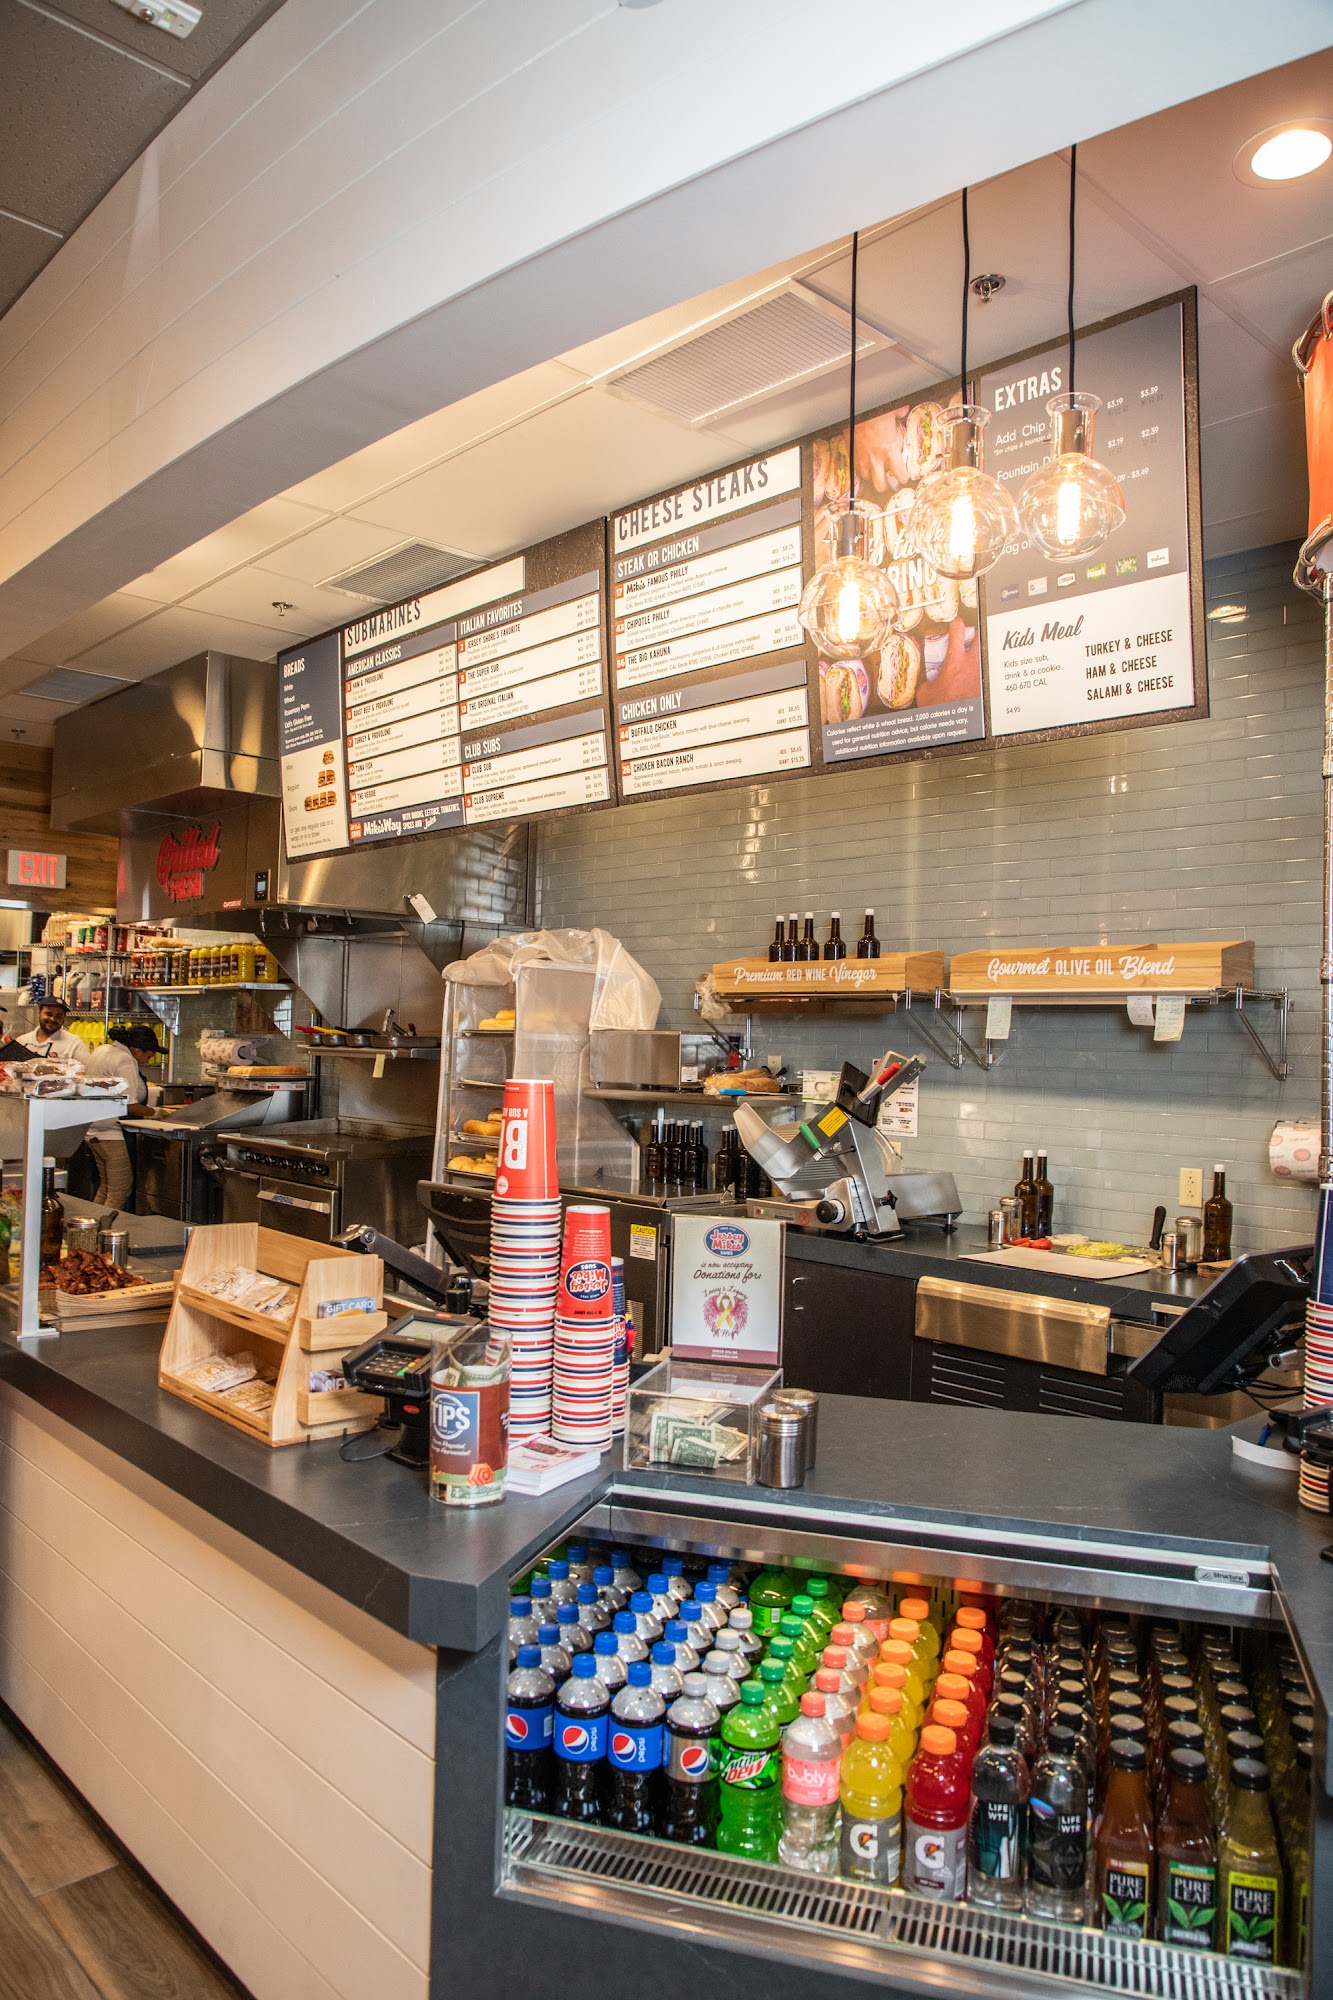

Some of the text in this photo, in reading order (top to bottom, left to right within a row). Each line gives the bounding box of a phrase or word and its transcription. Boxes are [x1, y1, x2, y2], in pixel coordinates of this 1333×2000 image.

[995, 367, 1062, 412] EXTRAS
[1107, 386, 1158, 409] $3.19 $3.39
[995, 421, 1045, 446] Add Chip
[1108, 426, 1158, 448] $2.19 $2.39
[997, 459, 1038, 482] Fountain
[1131, 468, 1149, 479] $3.49
[619, 460, 768, 540] CHEESE STEAKS
[618, 536, 699, 578] STEAK OR CHICKEN
[616, 566, 688, 596] 17 Mike's FAMOUS PHILLY
[348, 599, 420, 646] SUBMARINES
[461, 600, 522, 635] ITALIAN FAVORITES
[616, 610, 670, 632] 43 CHIPOTLE PHILLY
[467, 639, 481, 649] JERSEY
[483, 632, 499, 643] SHORE'S
[501, 624, 520, 636] FAVORITE
[1003, 615, 1084, 650] Kids Meal
[1085, 629, 1173, 657] TURKEY & CHEESE
[348, 645, 401, 676] AMERICAN CLASSICS
[617, 646, 671, 668] 56 THE BIG KAHUNA
[1004, 654, 1049, 668] Kids size sub,
[1086, 655, 1157, 679] HAM & CHEESE
[284, 658, 305, 678] BREADS
[476, 667, 489, 677] SUPER
[491, 664, 499, 672] SUB
[1005, 672, 1020, 680] drink
[1038, 664, 1062, 674] cookie.
[1005, 678, 1047, 691] 460-670 CAL
[1087, 676, 1174, 700] SALAMI & CHEESE
[478, 698, 496, 708] ORIGINAL
[498, 692, 514, 702] ITALIAN
[622, 692, 682, 720] CHICKEN ONLY
[1006, 706, 1020, 714] $4.95
[620, 720, 677, 739] 44 BUFFALO CHICKEN
[852, 734, 870, 743] general
[891, 728, 908, 736] advice,
[956, 717, 968, 726] vary.
[465, 744, 481, 759] CLUB
[483, 737, 501, 754] SUBS
[835, 747, 858, 755] additional
[879, 739, 906, 748] information
[908, 734, 931, 743] available
[932, 732, 945, 740] upon
[947, 728, 968, 738] request.
[472, 765, 482, 773] CLUB
[483, 763, 491, 771] SUB
[622, 754, 694, 774] 26 CHICKEN BACON RANCH
[474, 796, 484, 804] CLUB
[486, 792, 504, 802] SUPREME
[19, 853, 59, 885] EXIT
[156, 823, 220, 894] Grilled
[170, 872, 203, 903] FRESH
[734, 962, 877, 988] Premium RED WINE Vinegar
[987, 956, 1175, 982] Gourmet OLIVE OIL Blend
[508, 1108, 528, 1118] A SUB
[710, 1230, 744, 1243] Jersey
[712, 1240, 742, 1250] Mike's
[570, 1268, 605, 1283] Mike's
[694, 1269, 761, 1283] Donations for:
[723, 1262, 753, 1270] accepting
[570, 1280, 607, 1294] Jersey
[326, 1300, 374, 1314] GIFT CARD
[431, 1402, 470, 1430] TIPS
[1214, 1572, 1243, 1580] Structural
[638, 1737, 646, 1763] pepsi
[729, 1755, 753, 1770] Mtn
[787, 1763, 827, 1787] bubly
[988, 1802, 1008, 1812] LIFE
[988, 1812, 1008, 1821] WTR
[1061, 1815, 1081, 1824] LIFE
[1061, 1824, 1080, 1833] WTR
[849, 1824, 877, 1859] G
[915, 1835, 944, 1869] G
[1110, 1873, 1144, 1888] PURE
[1174, 1877, 1211, 1894] PURE
[1109, 1885, 1143, 1899] LEAF
[1174, 1890, 1211, 1905] LEAF
[1234, 1888, 1272, 1903] PURE
[1234, 1899, 1271, 1914] LEAF
